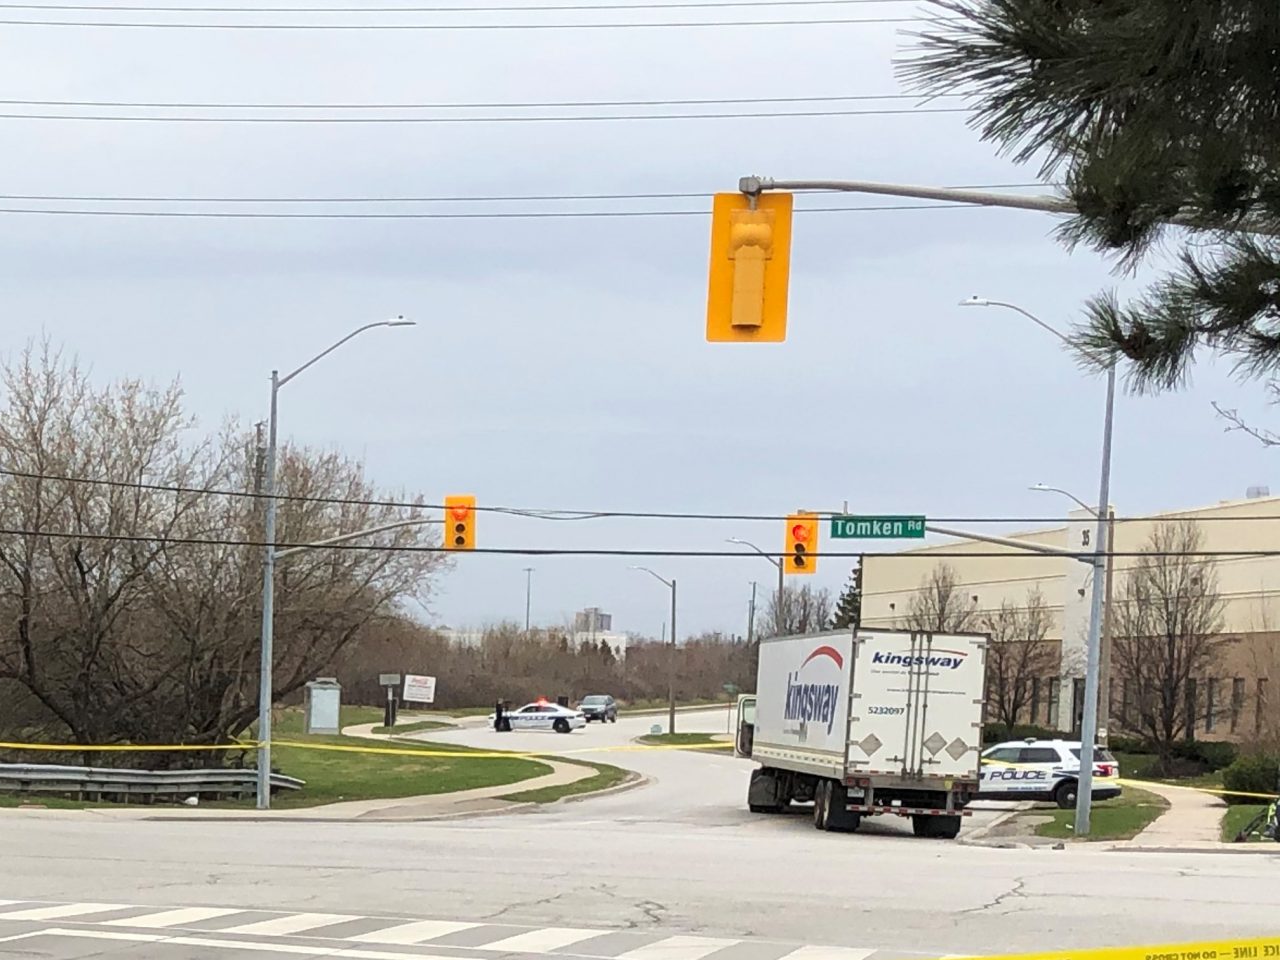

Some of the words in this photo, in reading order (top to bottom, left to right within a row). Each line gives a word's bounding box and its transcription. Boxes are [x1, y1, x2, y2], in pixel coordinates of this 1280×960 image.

[835, 520, 902, 535] Tomken
[908, 521, 922, 530] Rd
[872, 651, 964, 669] kingsway
[784, 671, 839, 735] kingsway
[868, 706, 905, 715] 5232097
[989, 770, 1047, 780] POLICE
